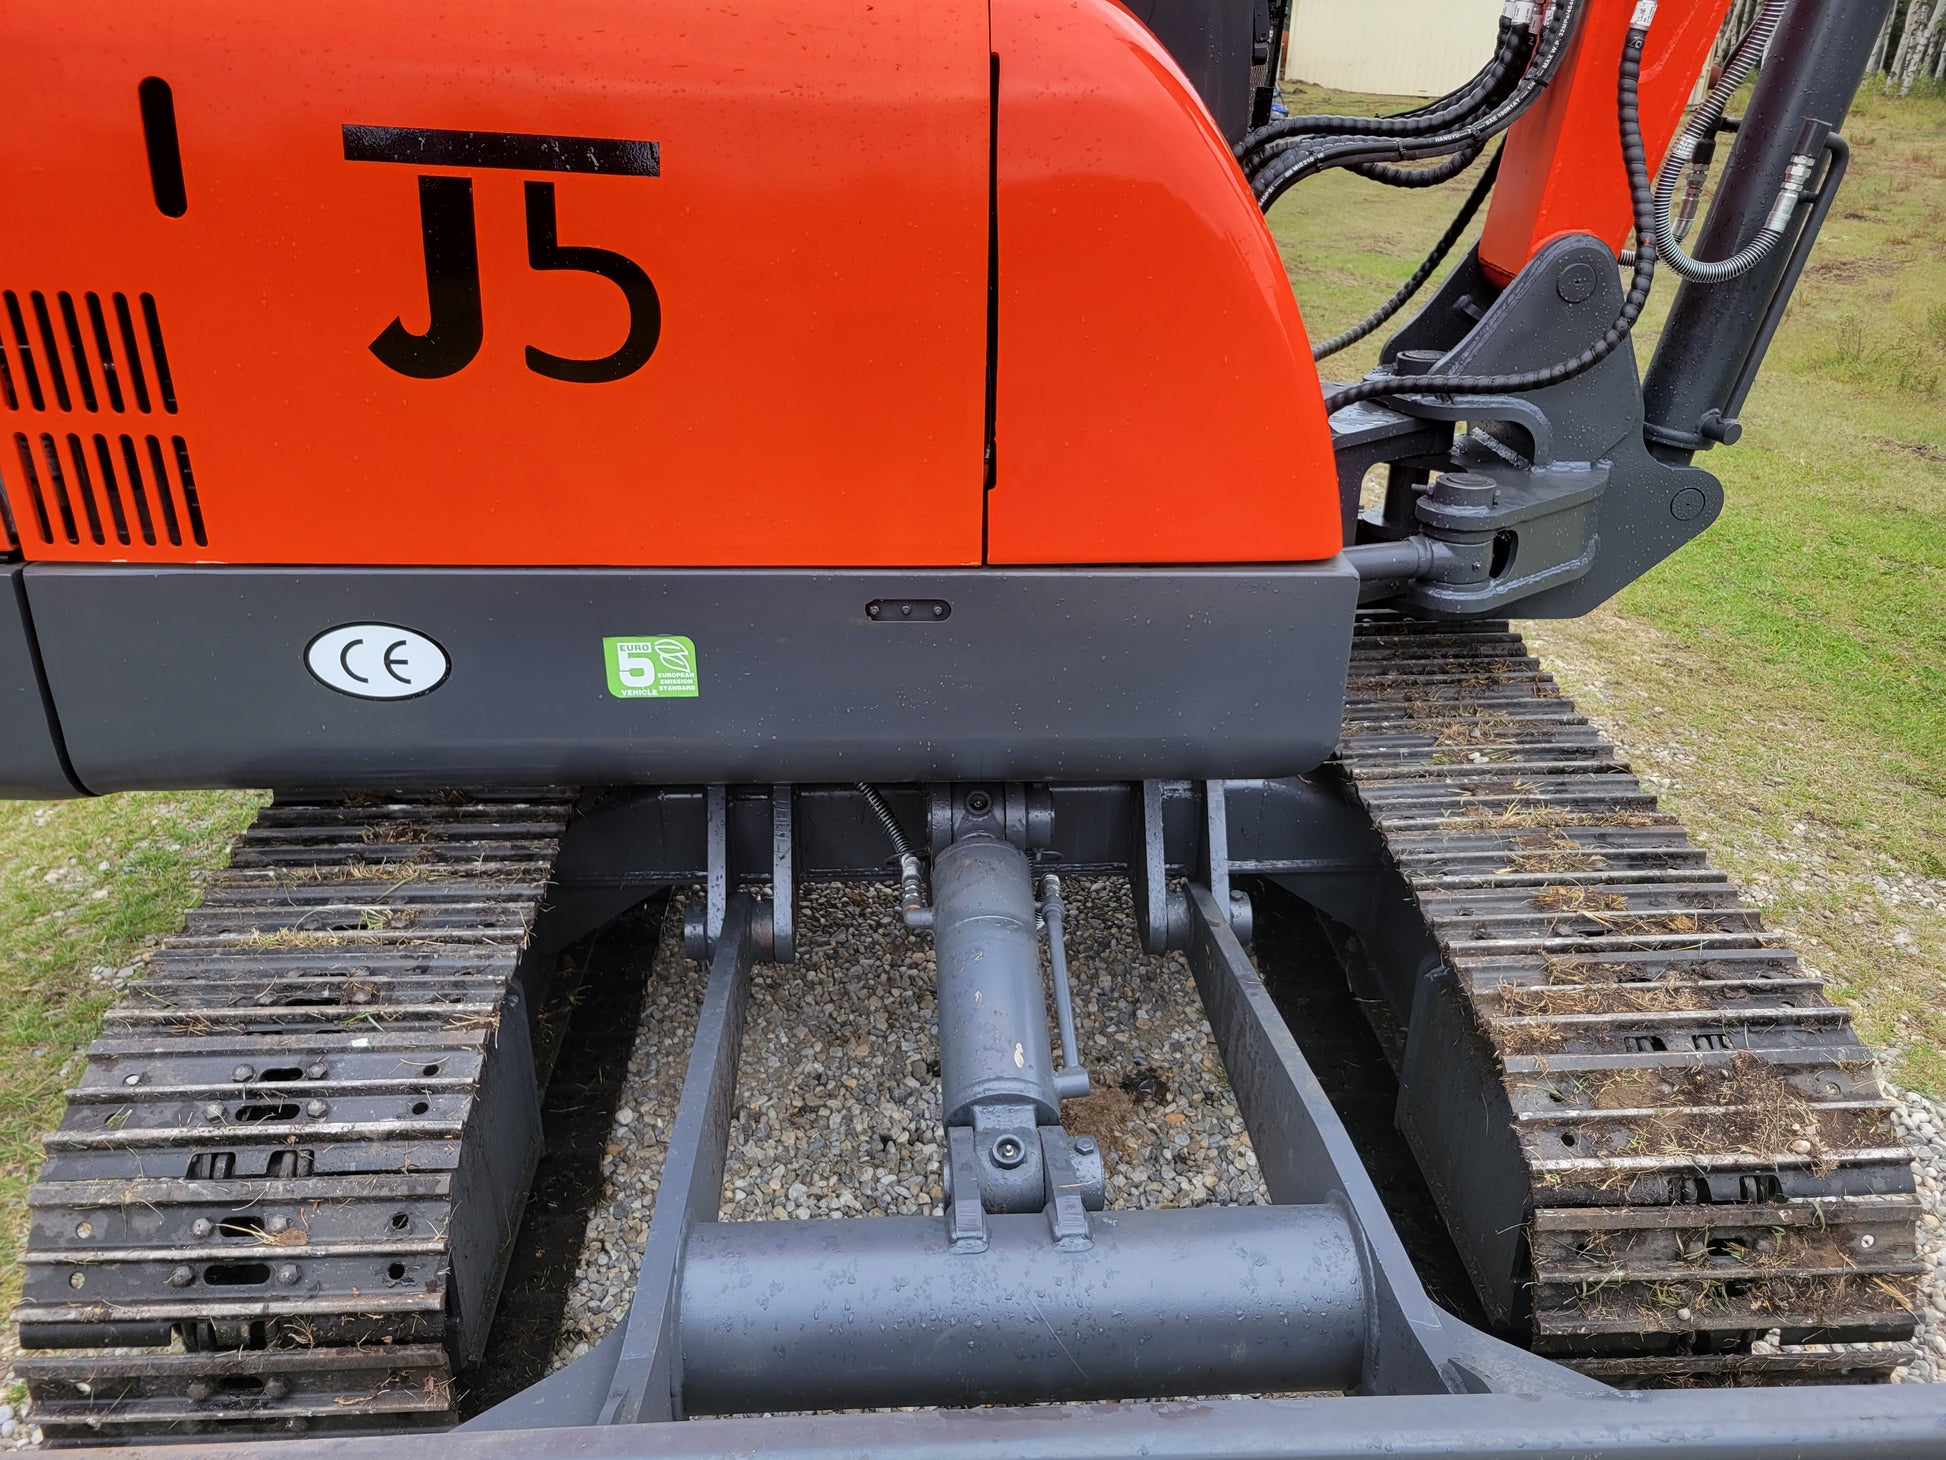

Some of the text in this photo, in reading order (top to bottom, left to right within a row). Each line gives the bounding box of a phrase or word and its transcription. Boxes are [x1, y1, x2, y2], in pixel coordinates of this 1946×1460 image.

[1542, 53, 1554, 69] MAX
[1558, 0, 1575, 38] 32MPa/464
[342, 123, 662, 384] J5
[339, 638, 412, 685] CE
[618, 652, 655, 687] 5
[619, 644, 649, 652] EURO
